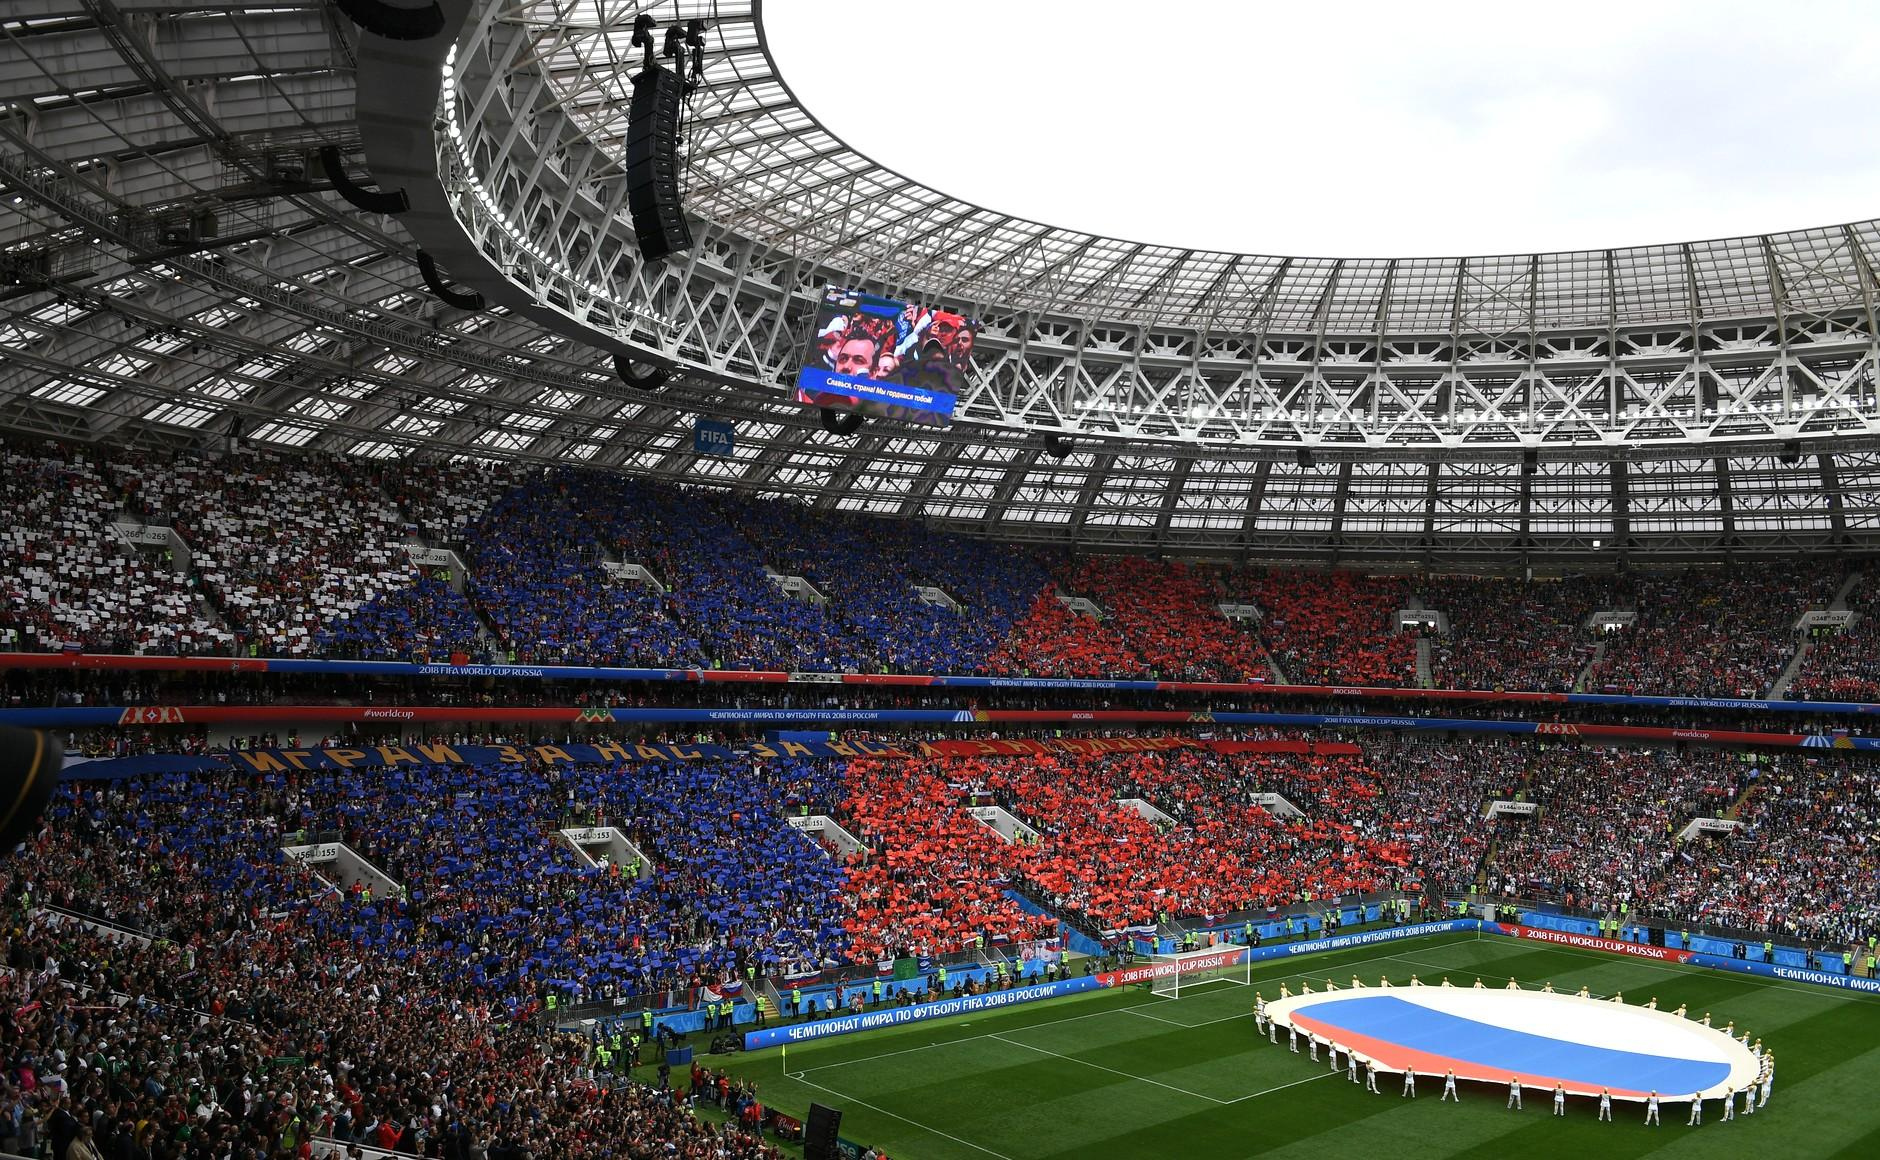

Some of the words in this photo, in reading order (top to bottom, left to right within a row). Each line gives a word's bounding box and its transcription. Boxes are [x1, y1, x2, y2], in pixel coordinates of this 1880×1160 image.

[876, 386, 886, 395] Мы
[700, 430, 728, 444] FIFA
[152, 532, 166, 540] 265
[364, 709, 414, 719] #worldcup
[1672, 730, 1710, 739] #worldcup
[322, 848, 336, 856] 155
[1289, 940, 1330, 954] ЧЕМПИОНАТ
[1331, 938, 1351, 948] МИРА
[1362, 931, 1391, 942] ФУТБОЛУ
[1392, 930, 1405, 938] FIFA
[1405, 927, 1419, 936] 2018
[1527, 929, 1547, 940] 2018
[1548, 932, 1568, 943] FIFA
[1569, 936, 1604, 948] WORLD
[1605, 941, 1625, 951] CUP
[1120, 972, 1137, 982] 2018
[1138, 968, 1154, 979] FIFA
[1182, 961, 1196, 970] CUP
[1773, 967, 1847, 987] ЧЕМПИОНАТ
[789, 1017, 859, 1040] ЧЕМПИОНАТ
[861, 1013, 894, 1028] МИРА
[896, 1010, 911, 1024] ПО
[913, 1001, 960, 1019] ФУТБОЛУ
[962, 998, 983, 1012] FIFA
[985, 995, 1007, 1008] 2018
[1008, 994, 1014, 1004] В
